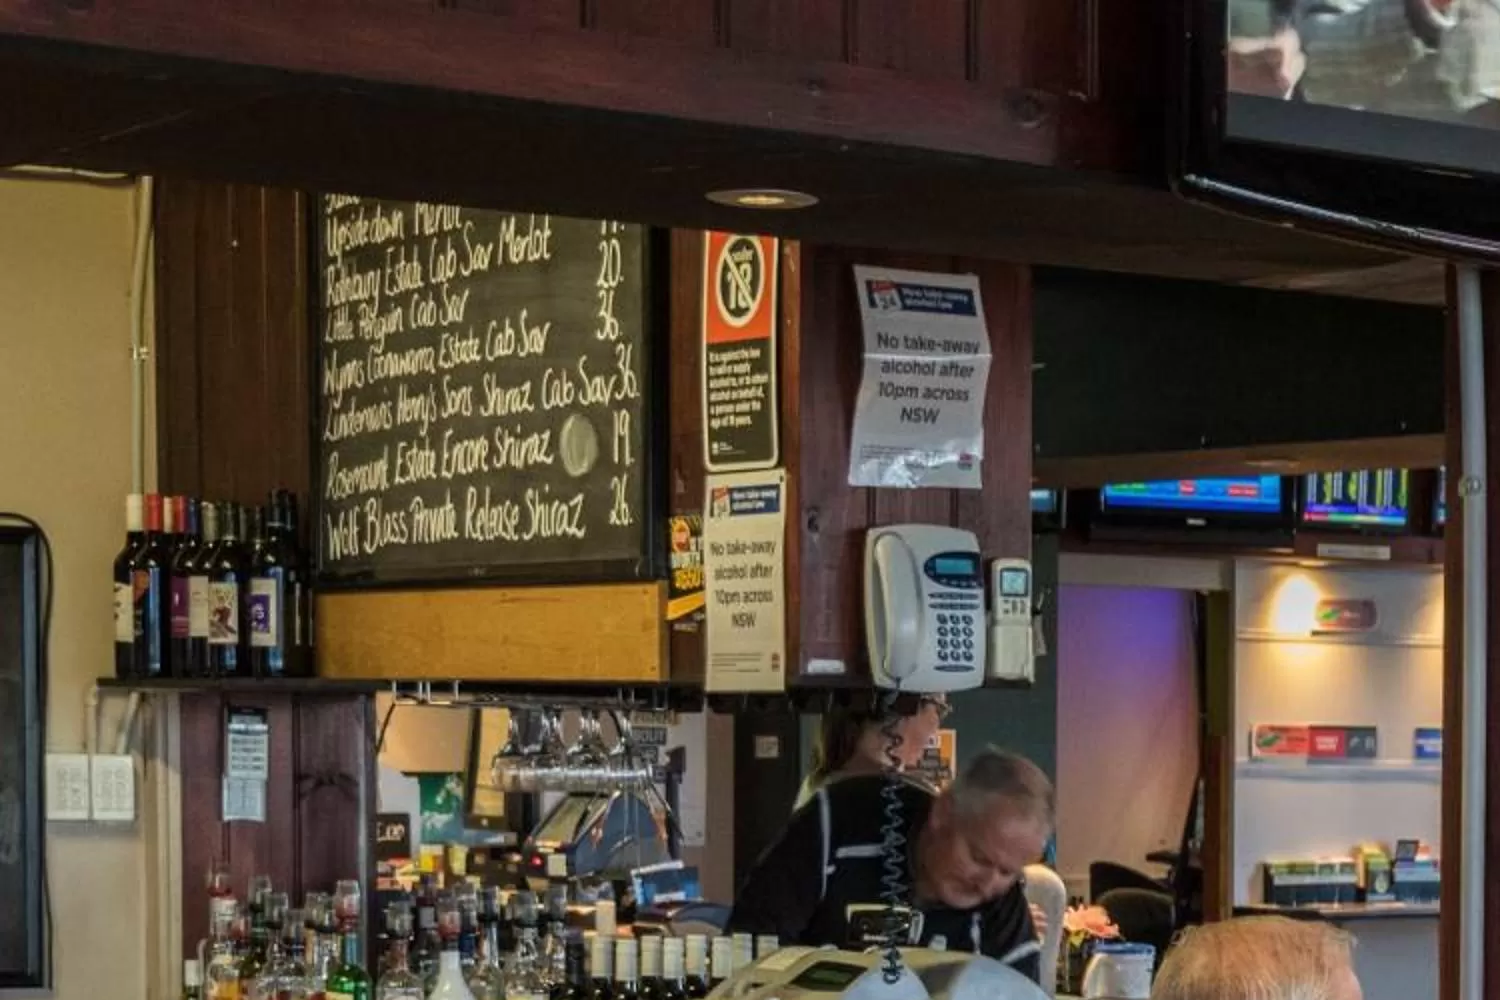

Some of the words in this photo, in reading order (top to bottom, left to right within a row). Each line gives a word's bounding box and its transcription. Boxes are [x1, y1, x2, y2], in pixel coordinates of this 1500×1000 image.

[429, 234, 457, 283] Cab
[460, 220, 494, 277] Sav
[498, 213, 552, 265] Merlot
[410, 291, 437, 330] Cab
[440, 284, 470, 326] Sav
[439, 327, 481, 369] Estate
[485, 317, 515, 361] Cab
[518, 308, 552, 357] Sav
[876, 331, 899, 349] No
[903, 334, 981, 355] take-away
[880, 358, 936, 377] alcohol
[939, 362, 975, 378] after
[480, 371, 535, 417] Shiraz
[541, 367, 575, 410] Cab
[579, 354, 617, 407] Sav
[879, 381, 919, 401] 10pm
[922, 385, 970, 401] across
[900, 406, 941, 425] NSW
[394, 435, 437, 484] Estate
[493, 424, 555, 469] Shiraz
[326, 505, 360, 560] Wolf
[363, 497, 408, 554] Blass
[465, 485, 520, 541] Release
[522, 483, 586, 541] Shiraz
[709, 540, 724, 556] No
[726, 537, 777, 556] take-away
[714, 564, 748, 581] alcohol
[750, 563, 774, 580] after
[743, 589, 773, 605] across
[731, 612, 757, 629] NSW
